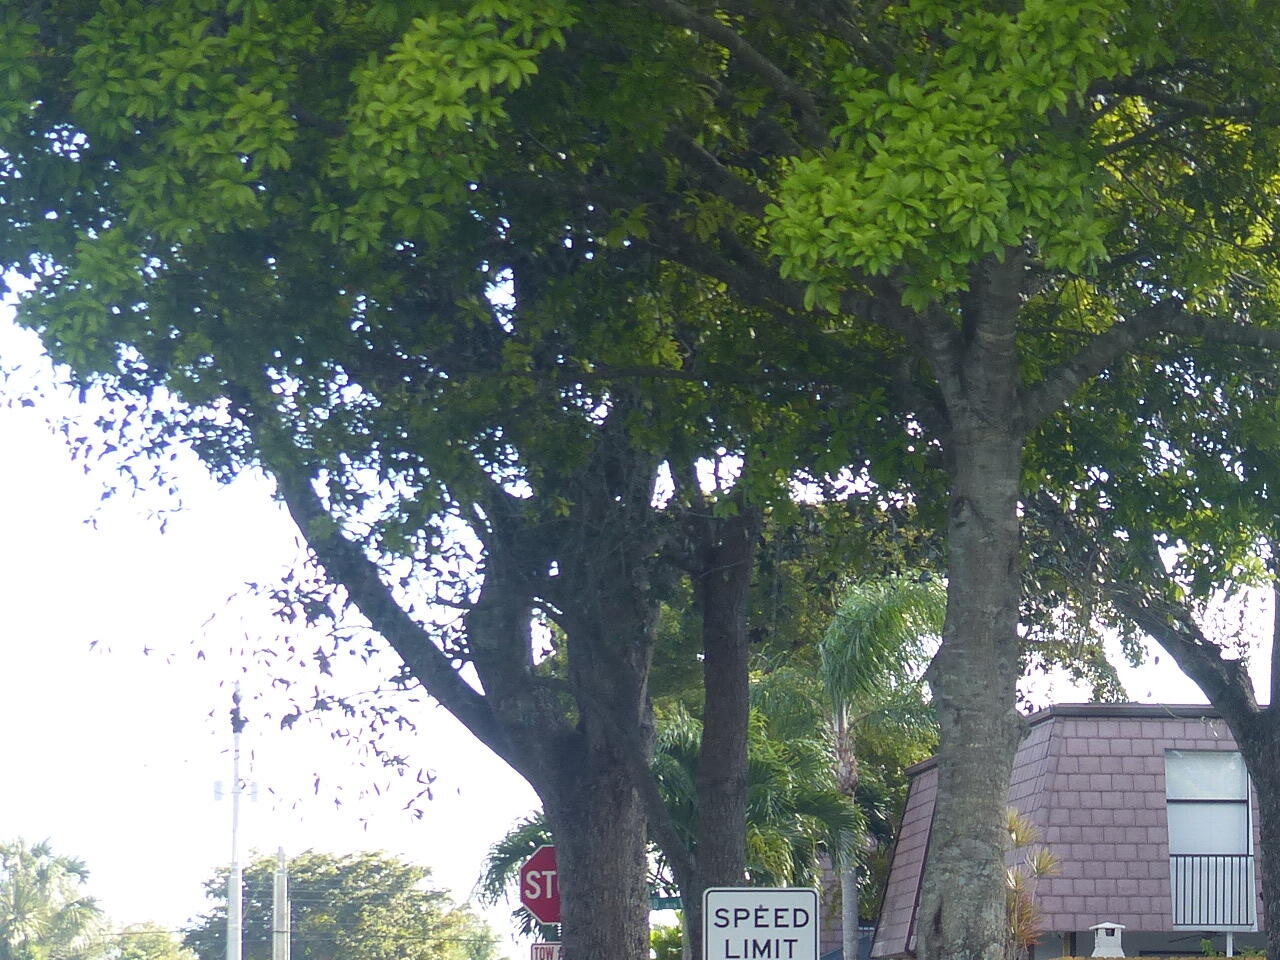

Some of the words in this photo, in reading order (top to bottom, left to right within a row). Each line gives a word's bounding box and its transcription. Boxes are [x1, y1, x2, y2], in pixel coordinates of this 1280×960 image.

[525, 870, 560, 899] ST
[714, 908, 810, 928] SPEED
[534, 946, 554, 960] TOW
[725, 939, 798, 959] LIMIT
